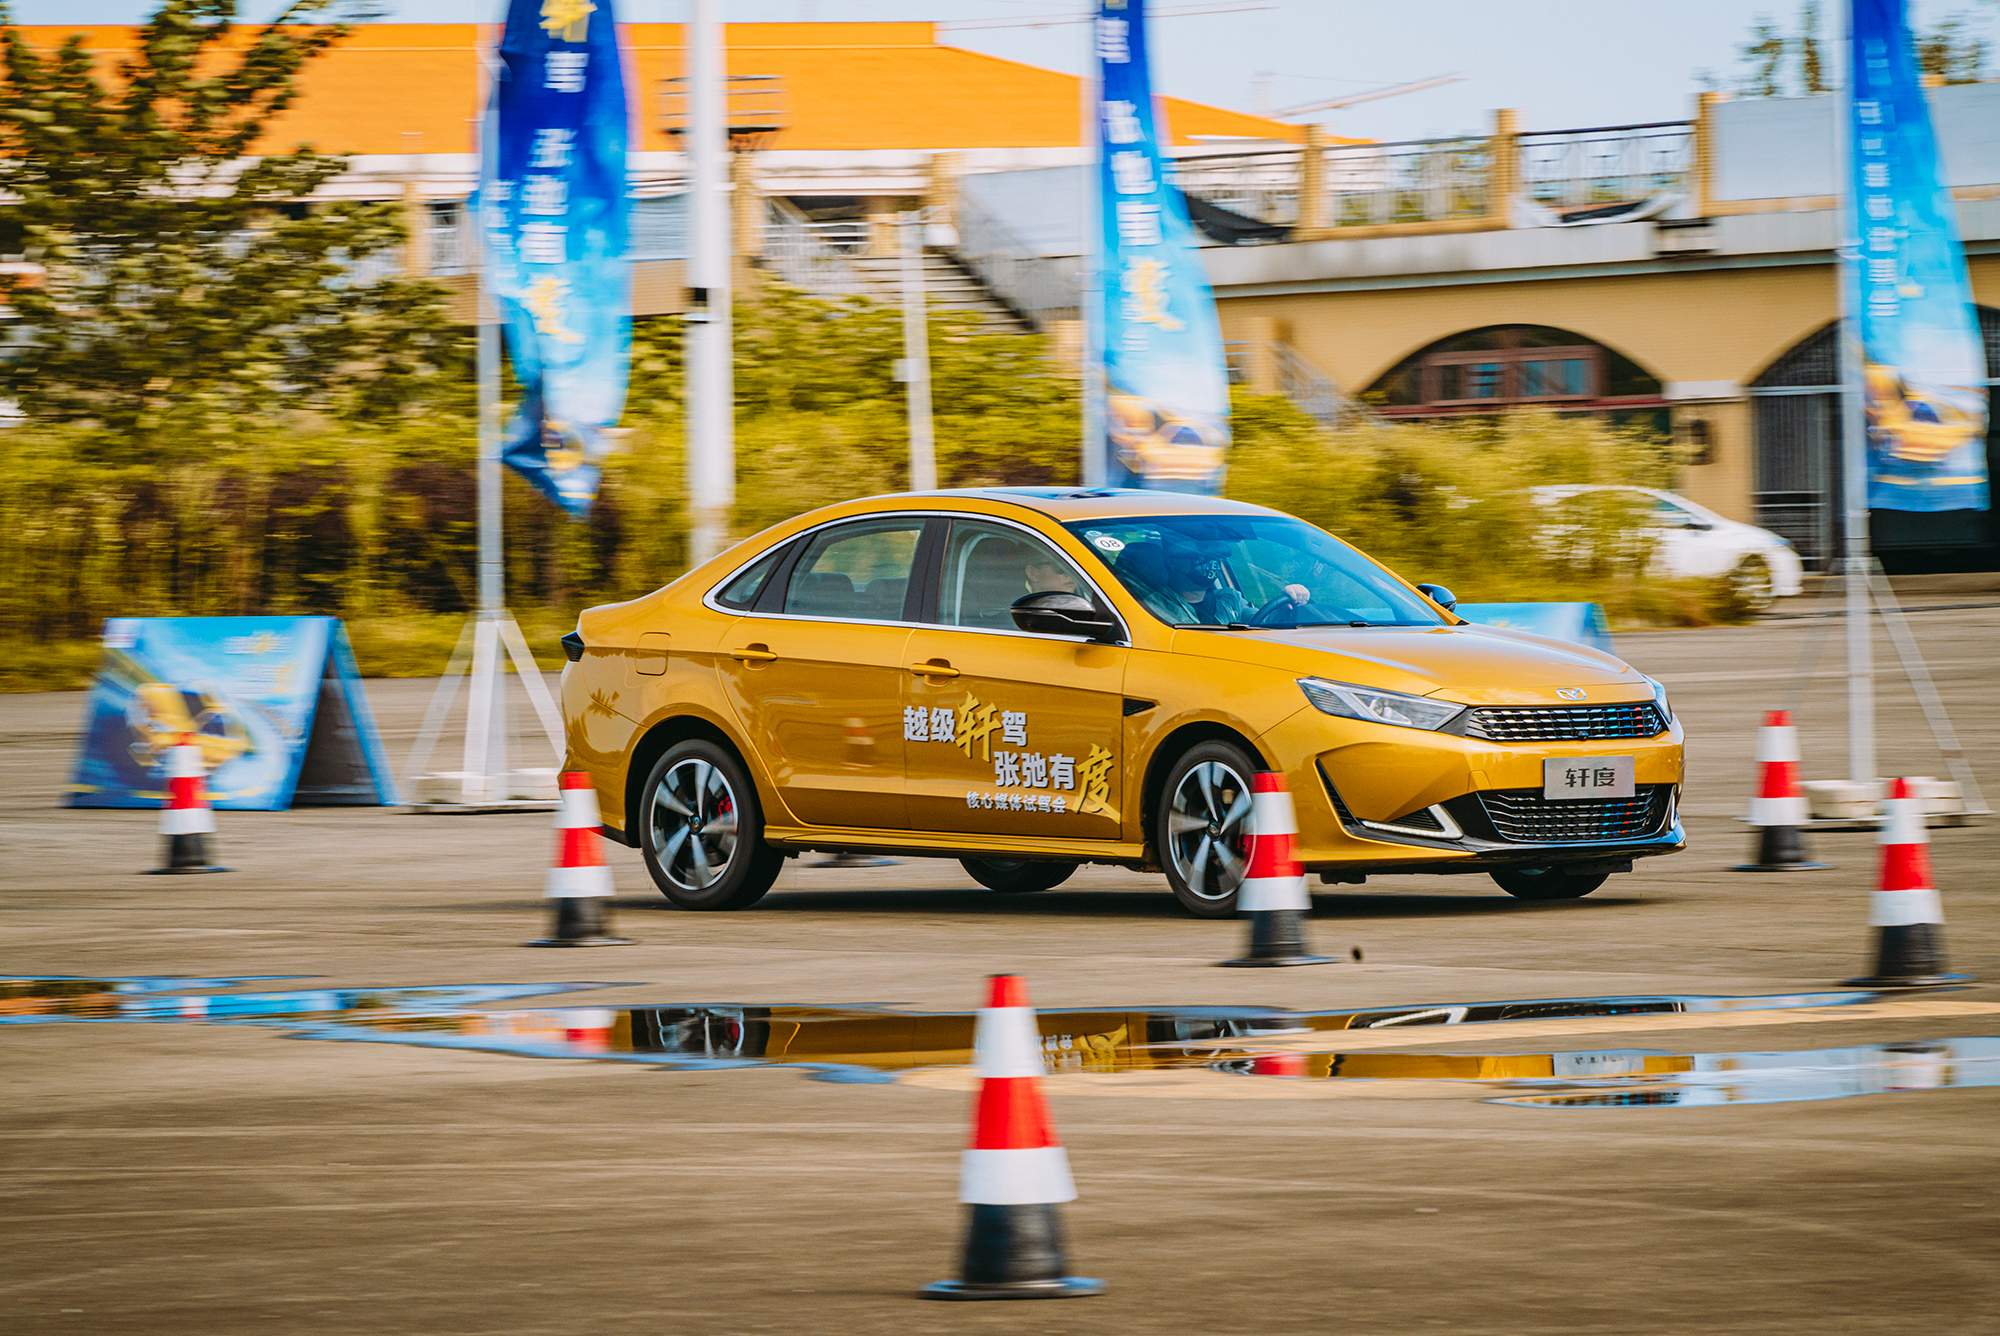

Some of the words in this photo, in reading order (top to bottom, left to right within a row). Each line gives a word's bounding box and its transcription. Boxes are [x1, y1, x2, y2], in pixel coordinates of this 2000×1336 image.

[1099, 539, 1120, 548] 08
[903, 690, 1027, 763] 越级轩驾
[993, 742, 1122, 825] 张弛有度
[1565, 767, 1616, 788] 轩度
[965, 790, 1068, 814] 核心媒体试驾会
